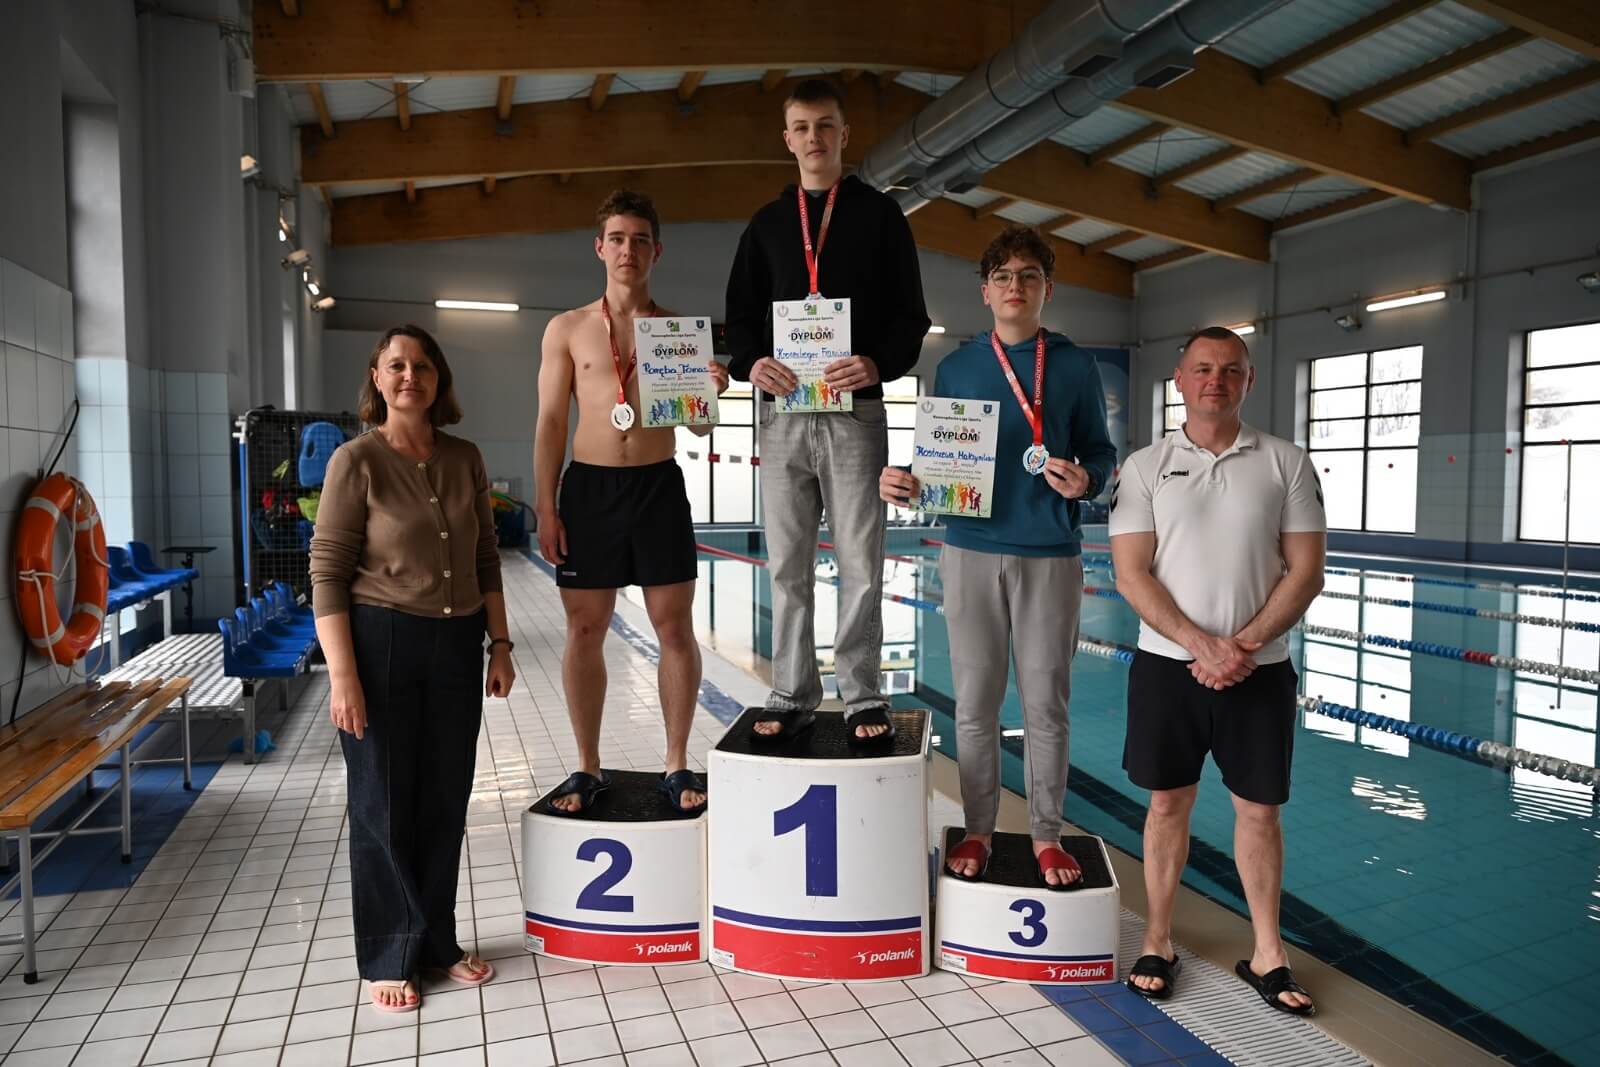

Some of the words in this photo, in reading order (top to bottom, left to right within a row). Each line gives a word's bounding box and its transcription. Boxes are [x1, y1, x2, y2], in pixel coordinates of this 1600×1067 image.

[791, 332, 832, 341] DYPLOM
[655, 347, 696, 357] DYPLOM
[933, 430, 978, 441] DYPLOM
[773, 784, 838, 897] 1
[576, 837, 634, 912] 2
[1008, 898, 1048, 948] 3
[647, 940, 693, 956] polanik
[869, 948, 915, 964] polanik
[1060, 966, 1107, 980] polanik
